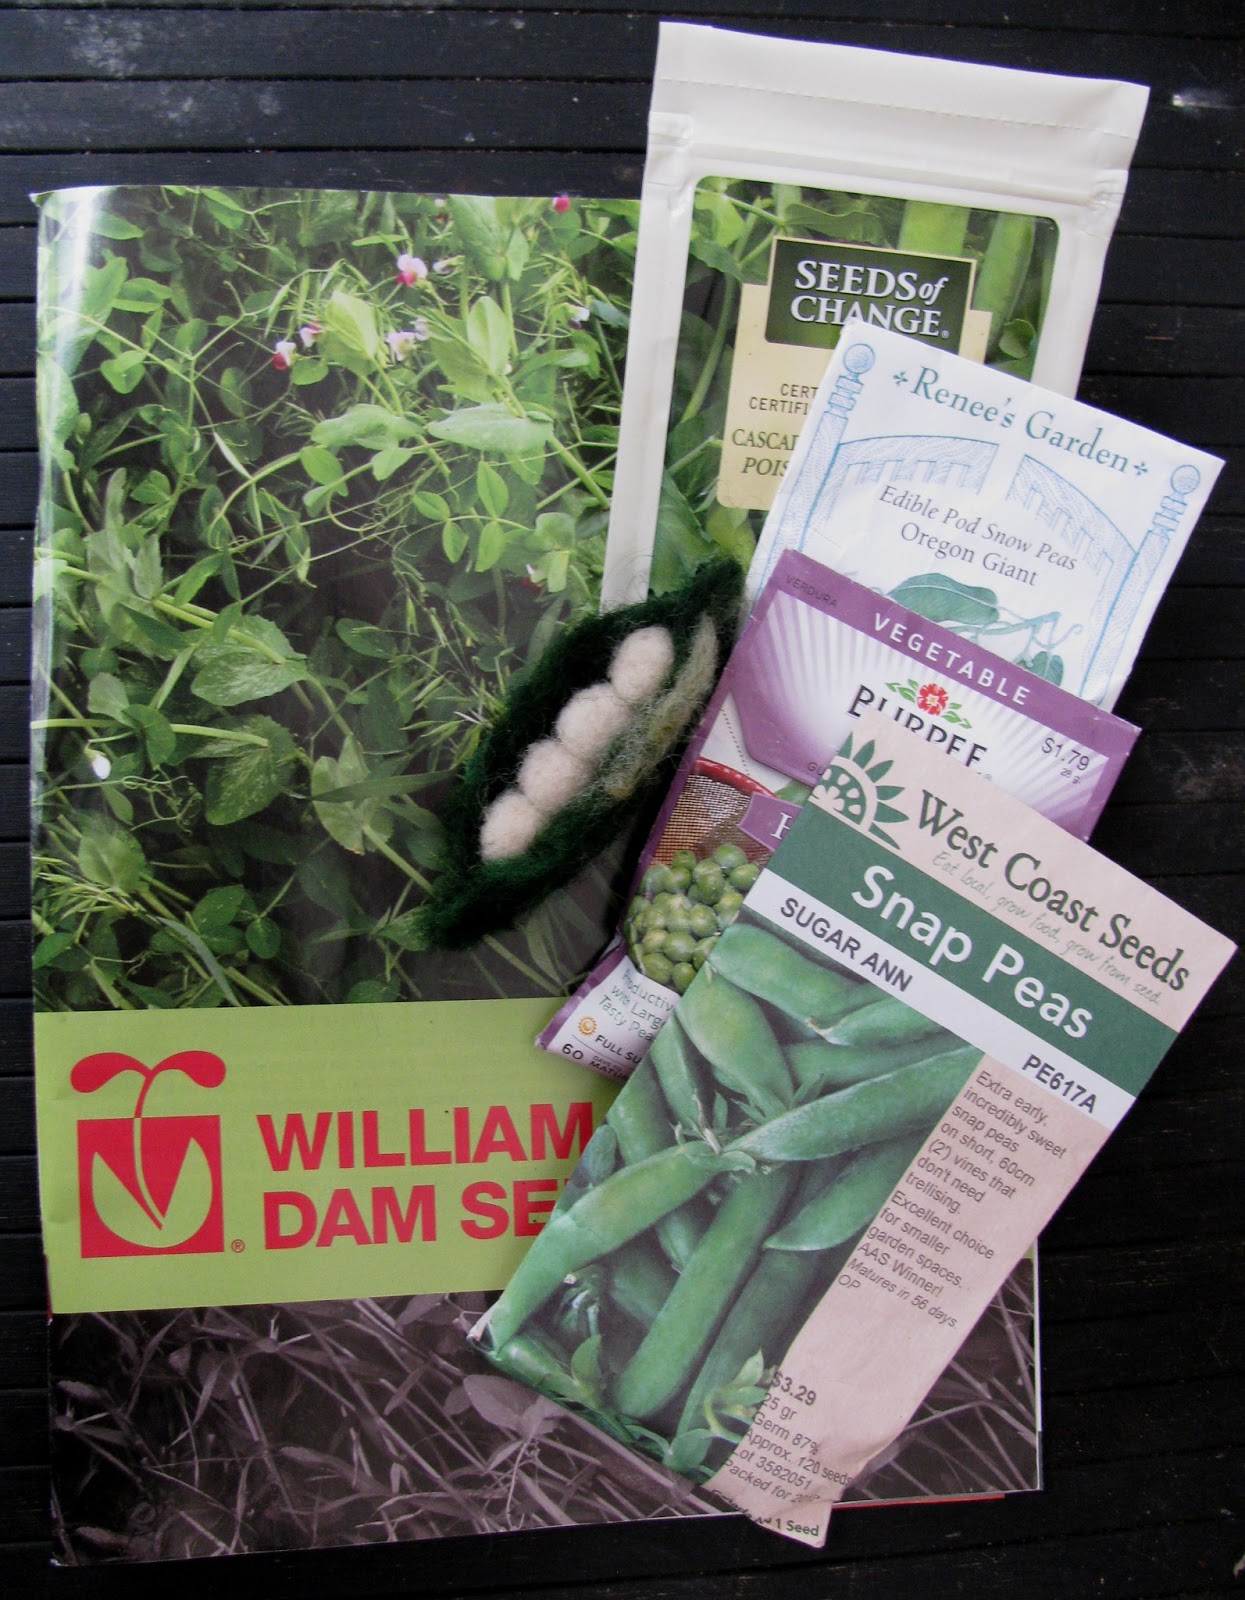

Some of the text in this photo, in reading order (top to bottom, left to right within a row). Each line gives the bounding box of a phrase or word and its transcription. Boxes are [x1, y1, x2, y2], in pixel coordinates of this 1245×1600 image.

[795, 260, 949, 305] SEEDS of
[790, 295, 941, 337] CHANGE
[749, 396, 808, 416] CERTIFI
[781, 383, 818, 399] CERT
[910, 366, 1129, 473] Renee's Garden
[879, 485, 1078, 571] Edible Pod Snow Peas
[901, 522, 1038, 586] Oregon Giant
[874, 612, 1030, 706] VEGETABLE
[919, 789, 1190, 992] West Coast Seeds
[932, 851, 954, 876] Eat
[994, 894, 1032, 920] grow
[1060, 938, 1101, 964] grow
[1099, 954, 1130, 986] from
[780, 897, 913, 993] SUGAR ANN
[851, 864, 1094, 1040] Snap Peas
[599, 995, 627, 1026] Tasty
[631, 1002, 666, 1031] Larg
[562, 1043, 584, 1060] 60
[595, 1034, 643, 1064] FULL SU
[976, 1070, 1049, 1127] Extra early,
[1022, 1054, 1097, 1114] PE617A
[257, 1101, 593, 1171] WILLIAM
[952, 1106, 1019, 1153] snap peas
[963, 1087, 1067, 1160] incredibly sweet
[940, 1122, 1035, 1187] on short, 60cm
[953, 1155, 987, 1181] vines
[989, 1175, 1017, 1199] that
[905, 1172, 961, 1215] trellising.
[917, 1156, 986, 1203] don't need
[263, 1178, 569, 1250] DAM SE
[880, 1207, 950, 1256] for smaller
[891, 1190, 995, 1259] Excellent choice
[857, 1242, 944, 1298] AAS Winner!
[867, 1226, 963, 1288] garden spaces.
[838, 1274, 861, 1290] OP
[848, 1258, 897, 1293] Matures
[898, 1287, 910, 1300] in
[911, 1295, 929, 1310] 56
[772, 1371, 816, 1406] $3.29
[753, 1412, 820, 1455] Germ 87%
[779, 1406, 797, 1420] gr
[746, 1429, 791, 1462] Approx.
[800, 1457, 820, 1474] 120
[756, 1456, 812, 1490] 3582051
[725, 1459, 771, 1490] Packed
[773, 1485, 791, 1500] for
[786, 1520, 819, 1537] Seed
